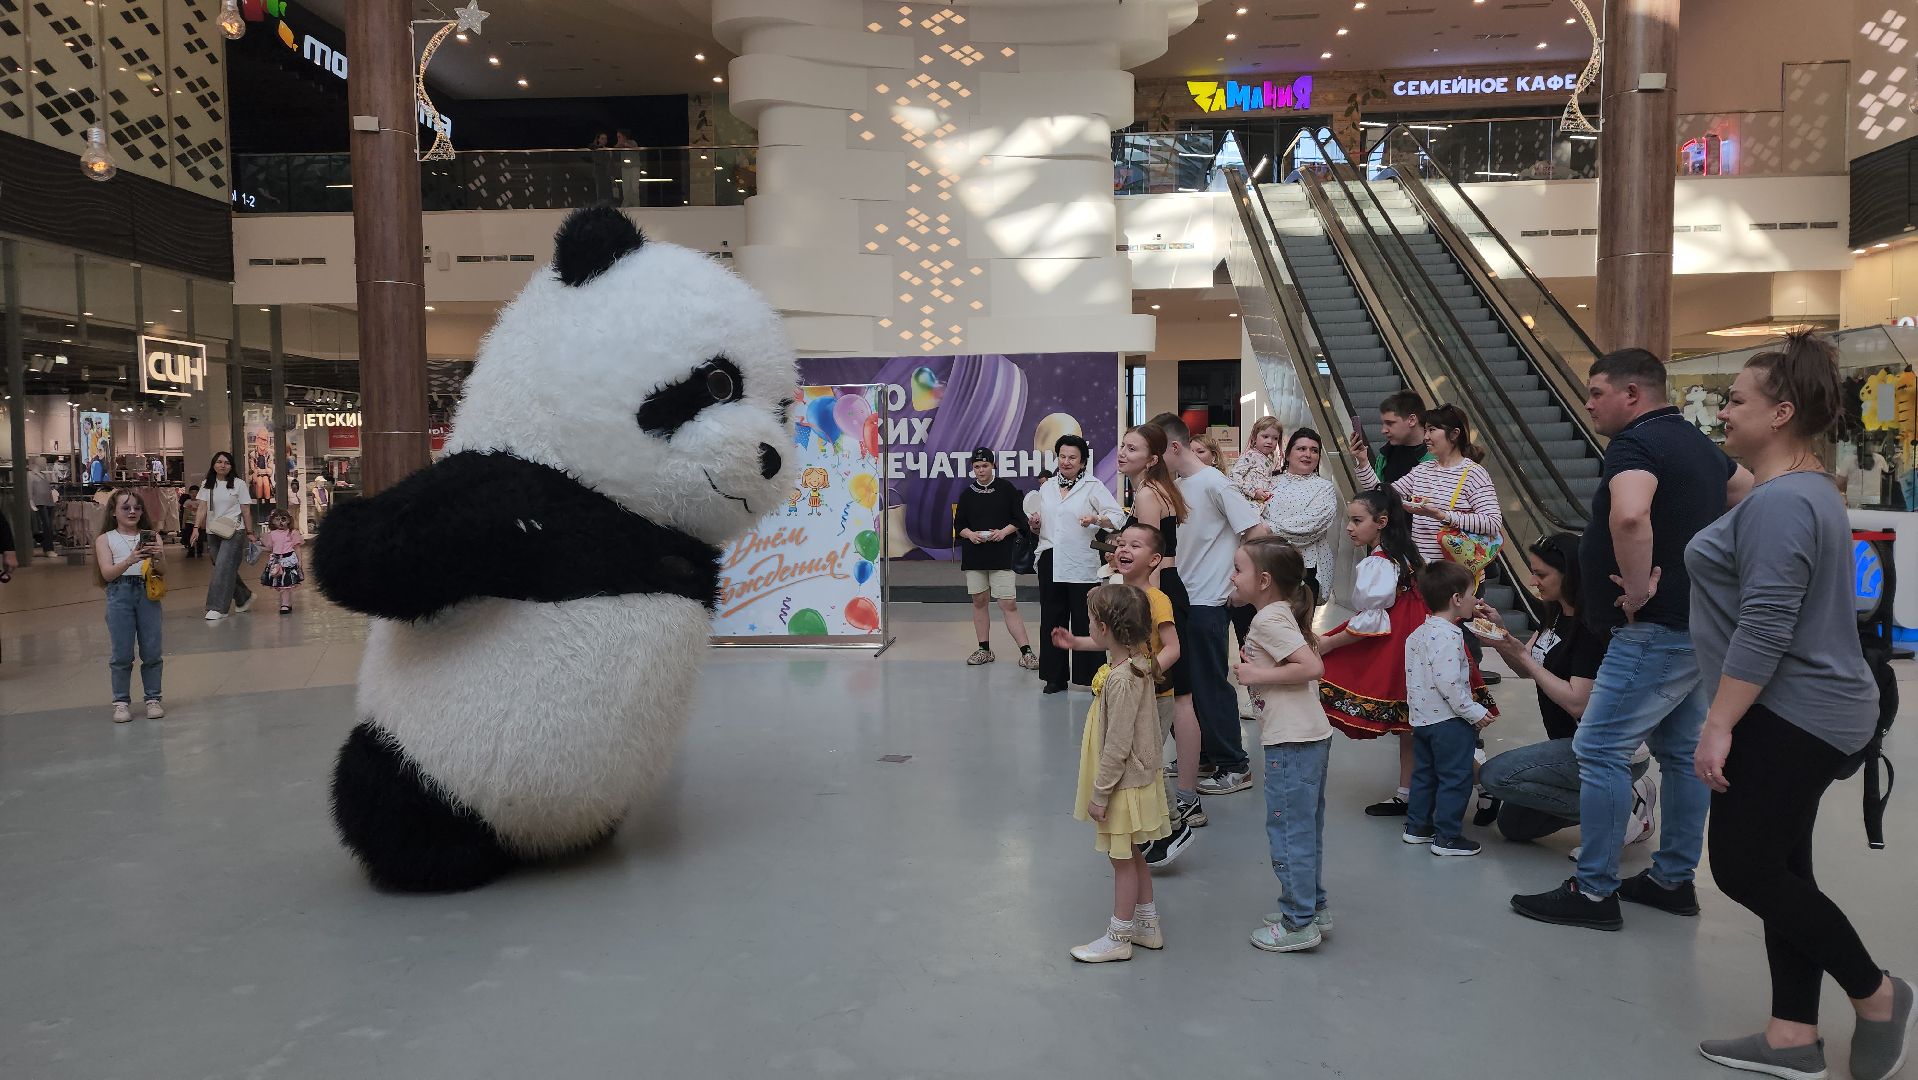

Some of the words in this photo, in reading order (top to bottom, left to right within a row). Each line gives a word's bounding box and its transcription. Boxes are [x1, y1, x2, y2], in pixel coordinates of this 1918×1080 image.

[1393, 75, 1508, 96] СЕМЕЙНОЕ
[1516, 73, 1577, 92] КАФЕ
[241, 192, 256, 208] 1-2
[718, 543, 851, 606] ождения!
